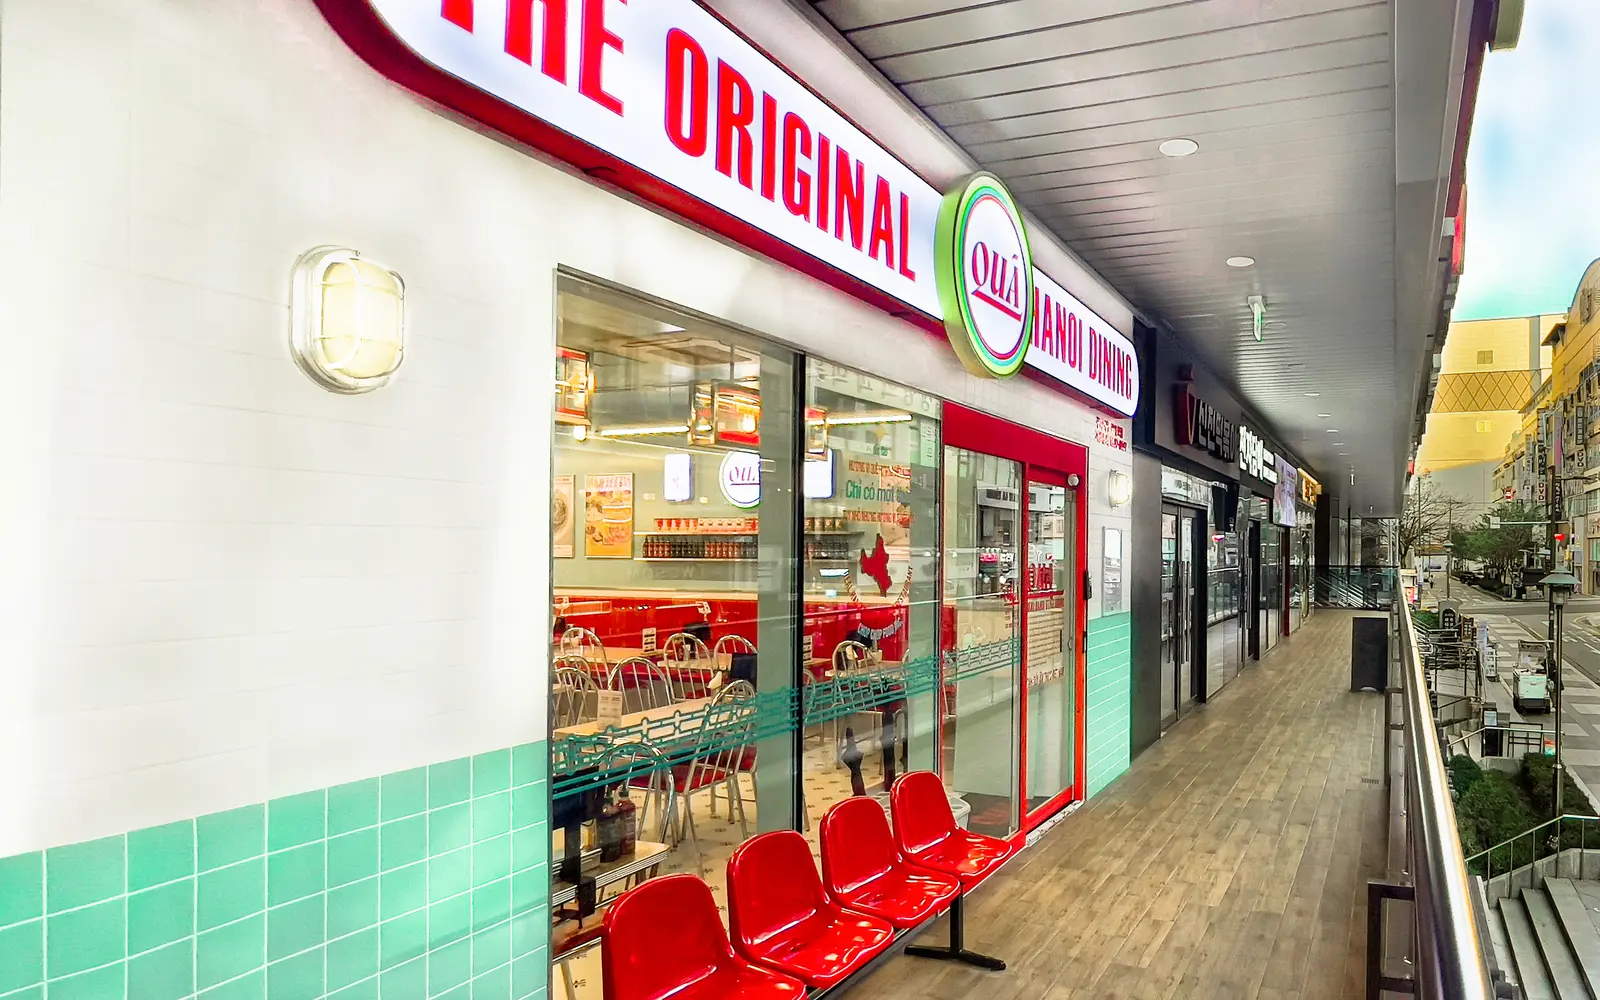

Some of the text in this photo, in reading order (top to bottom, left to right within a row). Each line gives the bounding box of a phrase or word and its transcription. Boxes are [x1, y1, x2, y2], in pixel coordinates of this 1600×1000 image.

[664, 27, 916, 282] ORIGINAL
[971, 241, 1023, 322] QUÁ
[1089, 326, 1132, 401] DINING
[863, 482, 875, 500] có
[1538, 482, 1546, 501] DVD
